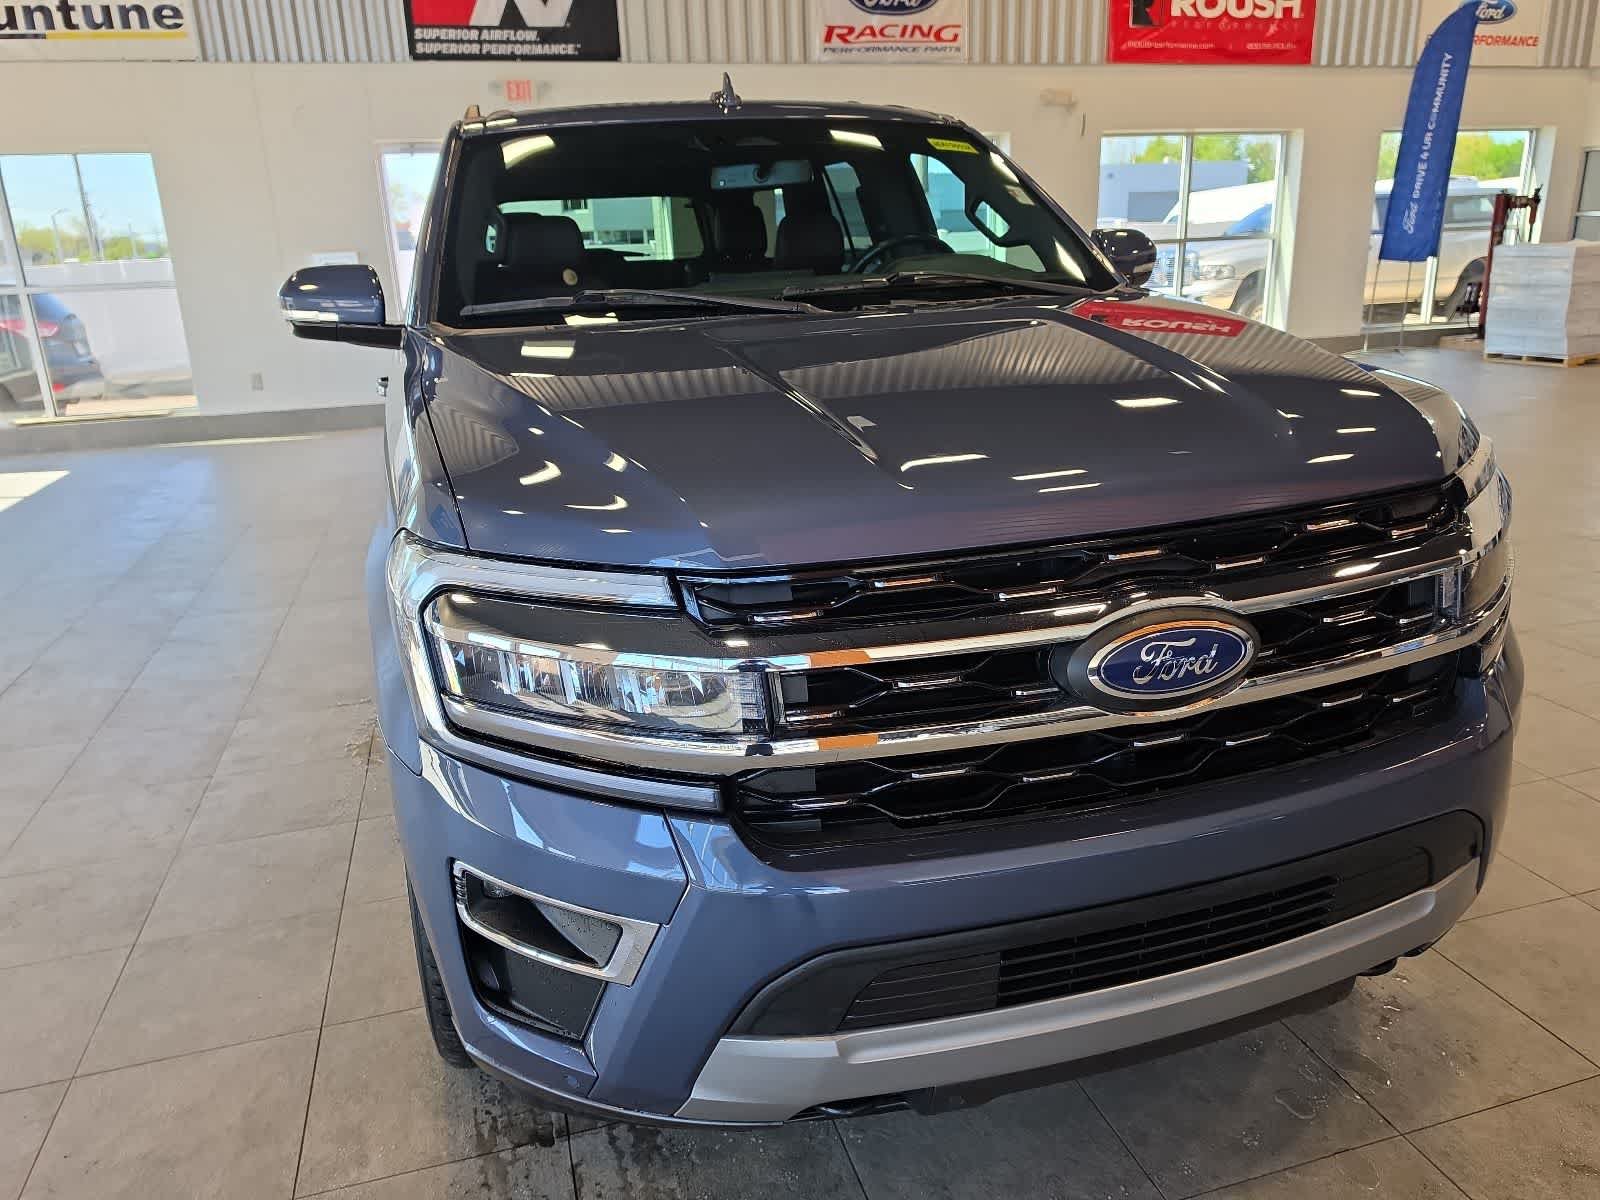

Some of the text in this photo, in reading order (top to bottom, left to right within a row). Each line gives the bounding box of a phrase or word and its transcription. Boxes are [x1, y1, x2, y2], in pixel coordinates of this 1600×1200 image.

[1170, 0, 1301, 18] ROUSH
[1475, 0, 1507, 19] Ford
[414, 28, 540, 41] SUPERIOR AIRFLOW.
[824, 24, 961, 44] RACING
[415, 42, 480, 54] SUPERIOR
[1402, 201, 1419, 234] Ford
[1412, 161, 1429, 198] DRIVE
[1132, 638, 1219, 685] Ford
